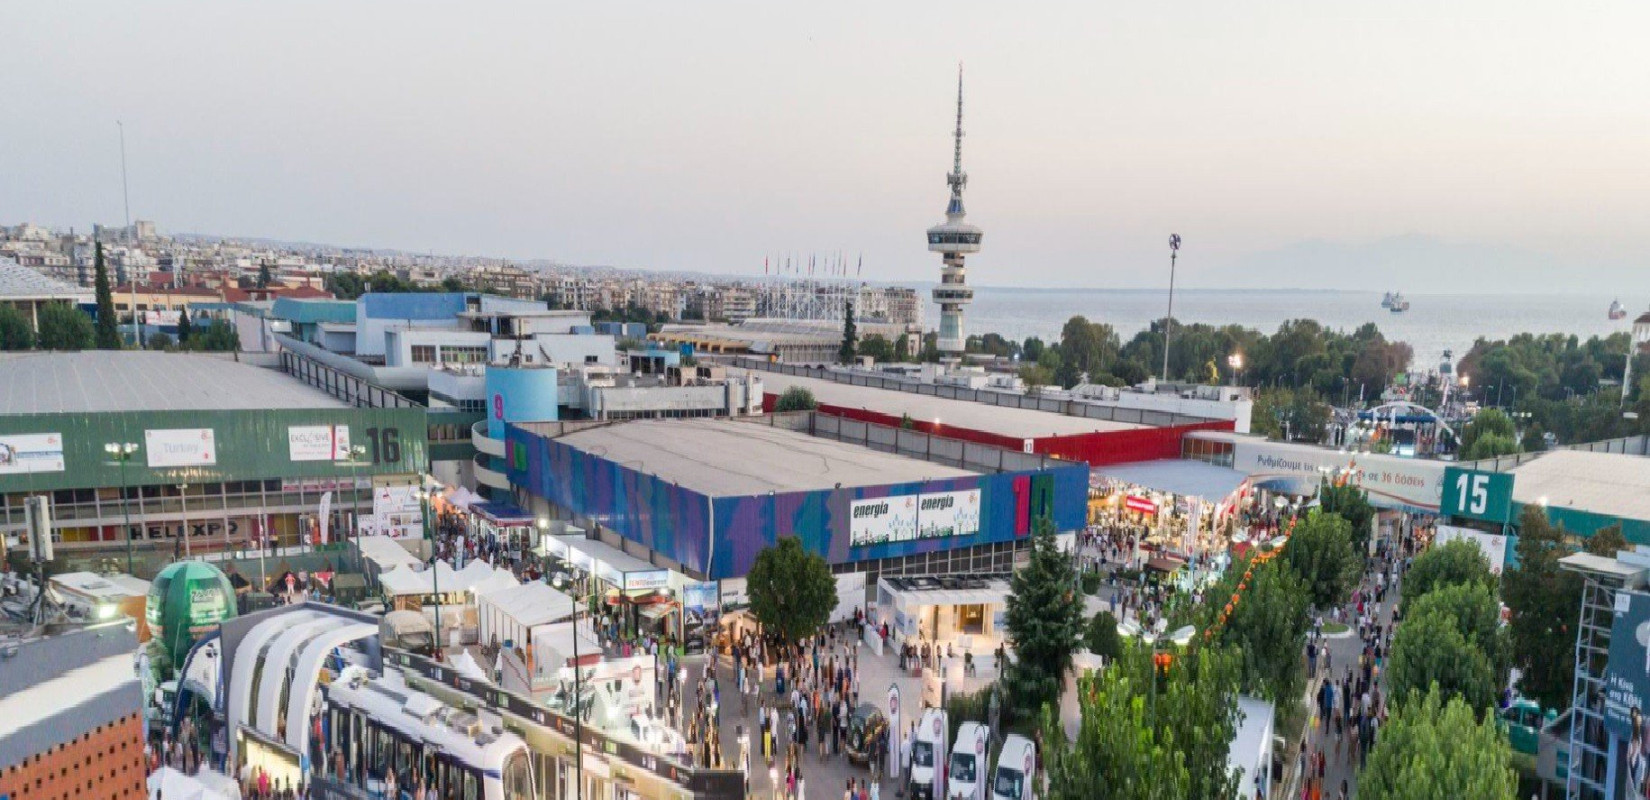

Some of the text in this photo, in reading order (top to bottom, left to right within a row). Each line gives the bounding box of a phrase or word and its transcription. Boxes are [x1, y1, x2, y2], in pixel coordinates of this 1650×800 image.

[494, 393, 504, 420] 9
[366, 427, 401, 464] 16
[1382, 471, 1392, 484] 36
[921, 494, 955, 511] energia
[1456, 473, 1490, 515] 15
[853, 501, 888, 518] energia
